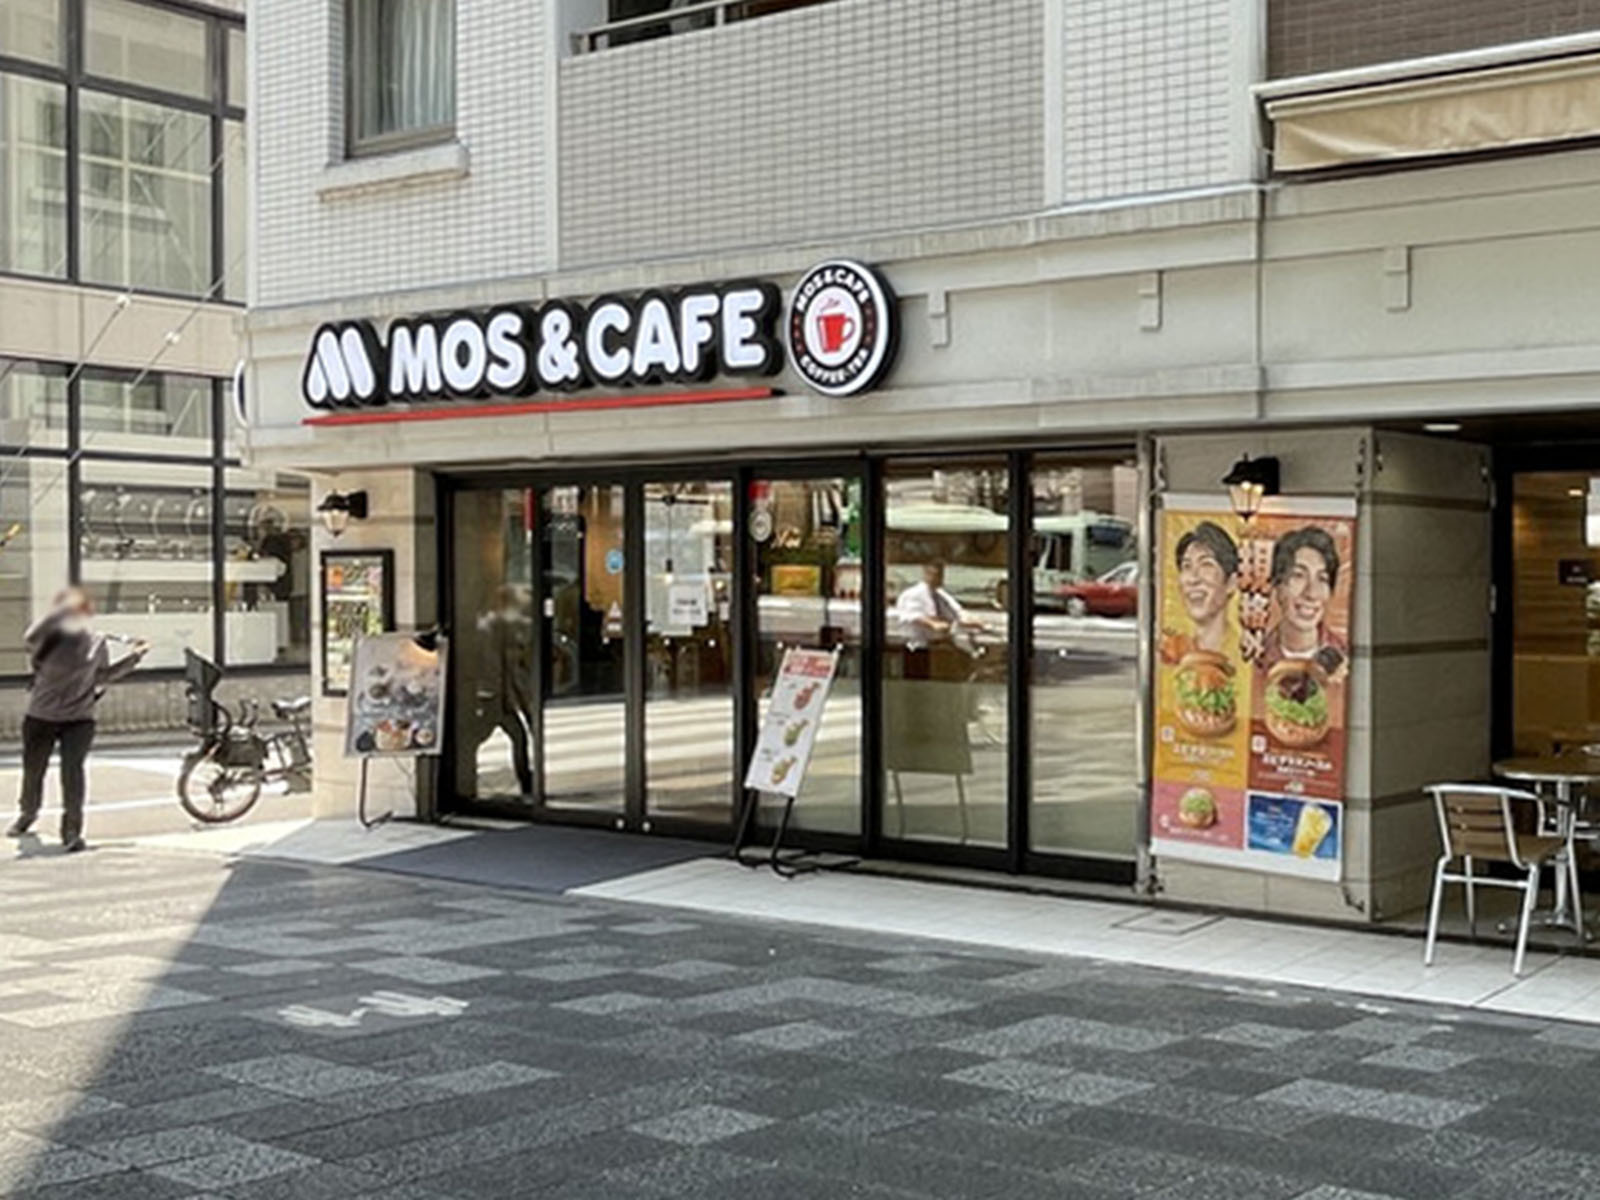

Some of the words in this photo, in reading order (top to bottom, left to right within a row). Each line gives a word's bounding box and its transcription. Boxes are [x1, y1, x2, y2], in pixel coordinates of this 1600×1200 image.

[390, 312, 526, 394] MOS
[539, 309, 580, 384] &
[586, 289, 766, 378] CAFE
